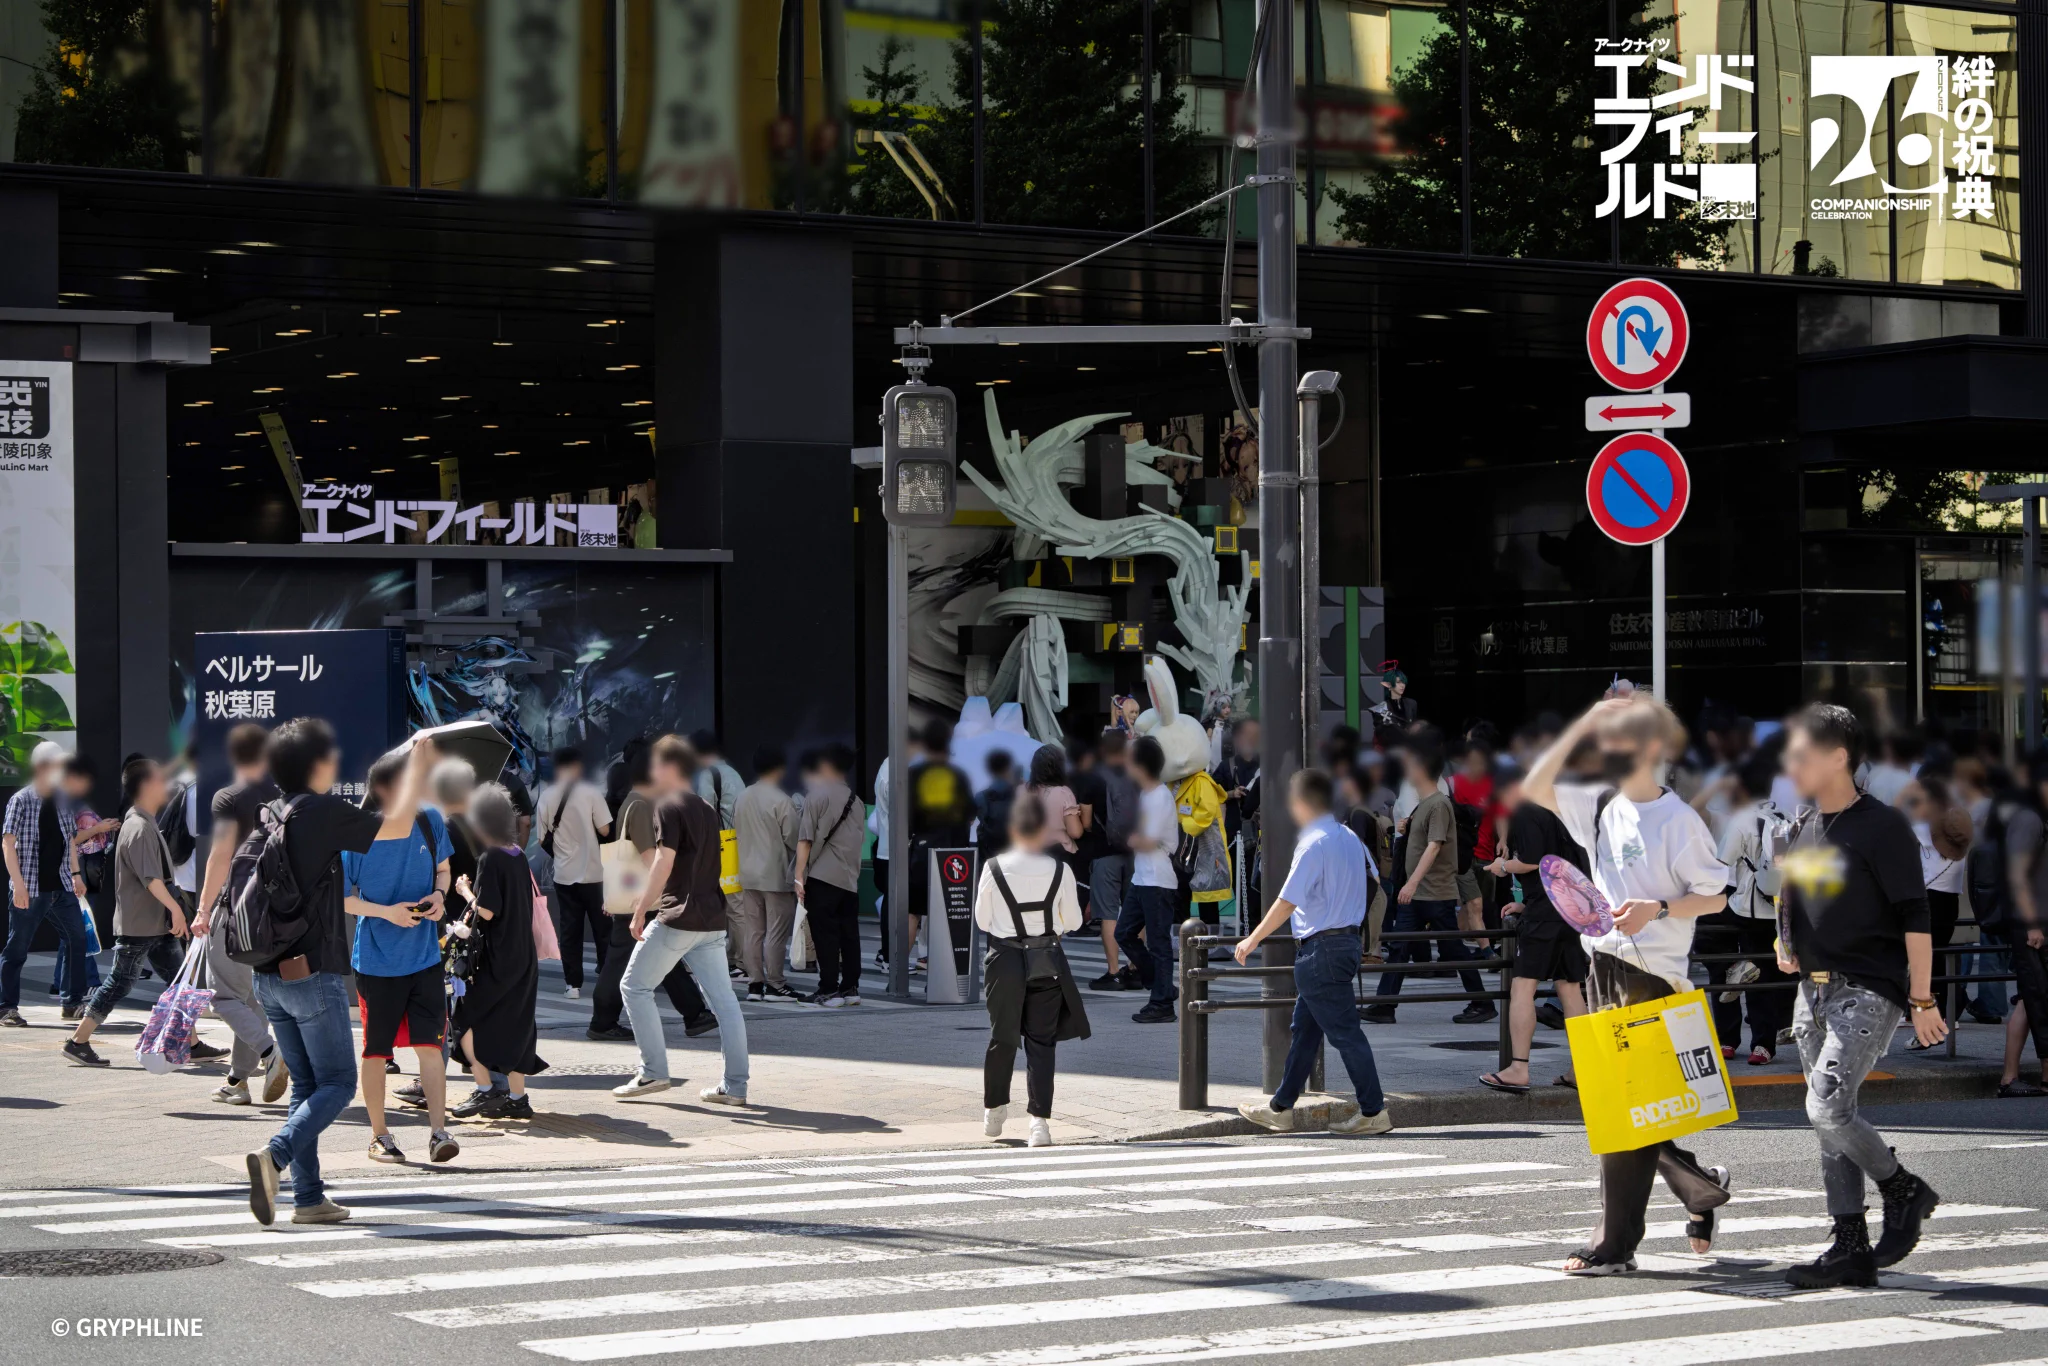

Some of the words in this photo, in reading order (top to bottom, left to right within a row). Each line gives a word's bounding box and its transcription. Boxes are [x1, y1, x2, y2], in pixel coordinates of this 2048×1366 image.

[0, 442, 52, 460] 陵印象
[0, 462, 26, 471] uLinG
[28, 463, 49, 471] Mart
[302, 483, 373, 499] アークナイツ
[302, 499, 577, 546] エンドフィールド
[205, 654, 324, 683] ベルサール
[205, 690, 276, 719] 秋葉原
